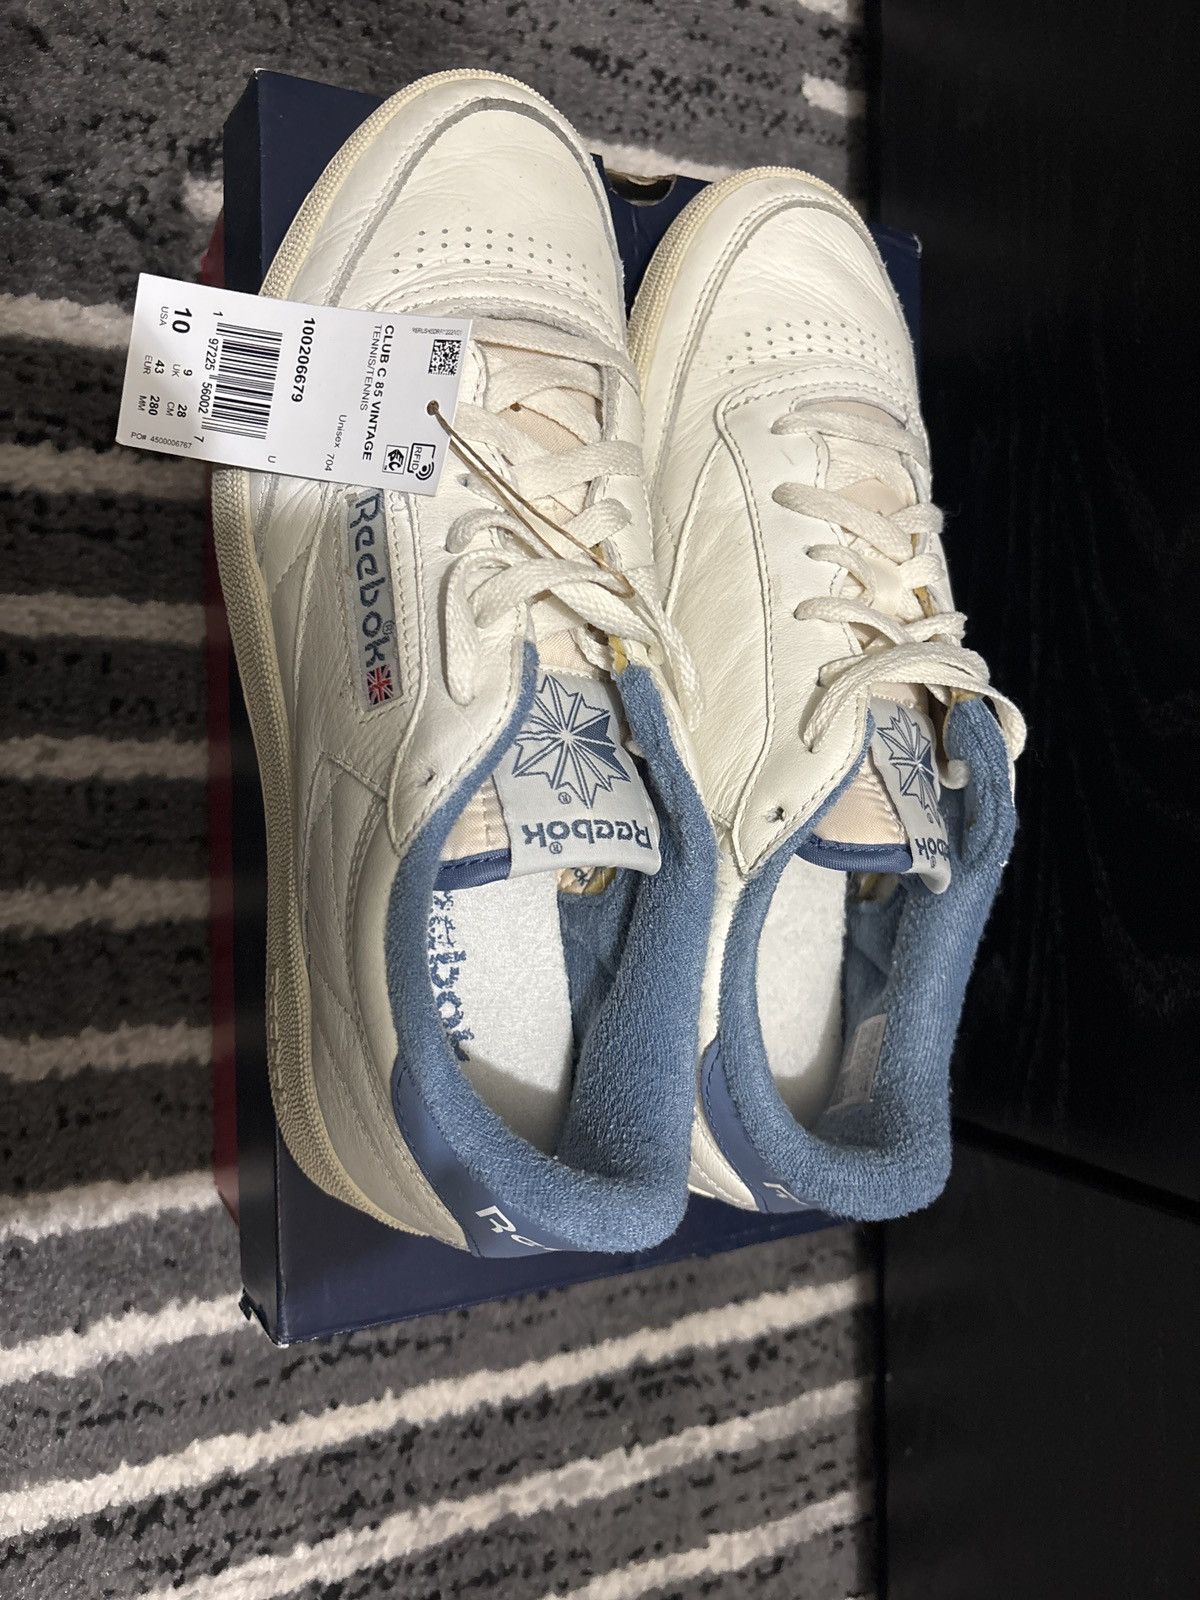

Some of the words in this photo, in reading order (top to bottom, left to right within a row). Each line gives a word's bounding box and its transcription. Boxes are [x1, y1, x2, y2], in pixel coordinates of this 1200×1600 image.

[159, 306, 169, 327] USA
[172, 308, 193, 334] 10
[204, 338, 219, 371] 97225
[379, 324, 395, 364] CLUB
[142, 354, 153, 375] EUR
[154, 359, 165, 375] 43
[171, 363, 181, 378] UK
[291, 317, 316, 403] 100206679
[360, 324, 383, 411] TENNIS/TENNIS
[183, 368, 193, 377] 9
[377, 367, 387, 378] C
[198, 381, 213, 415] 56002
[373, 381, 385, 397] 85
[138, 395, 147, 412] MM
[148, 395, 160, 416] 280
[165, 401, 176, 417] CM
[177, 403, 188, 418] 28
[193, 435, 205, 443] 7
[334, 414, 347, 448] Unisex
[362, 401, 382, 461] VINTAGE
[267, 455, 277, 464] U
[324, 453, 335, 472] 704
[411, 446, 423, 471] RFID
